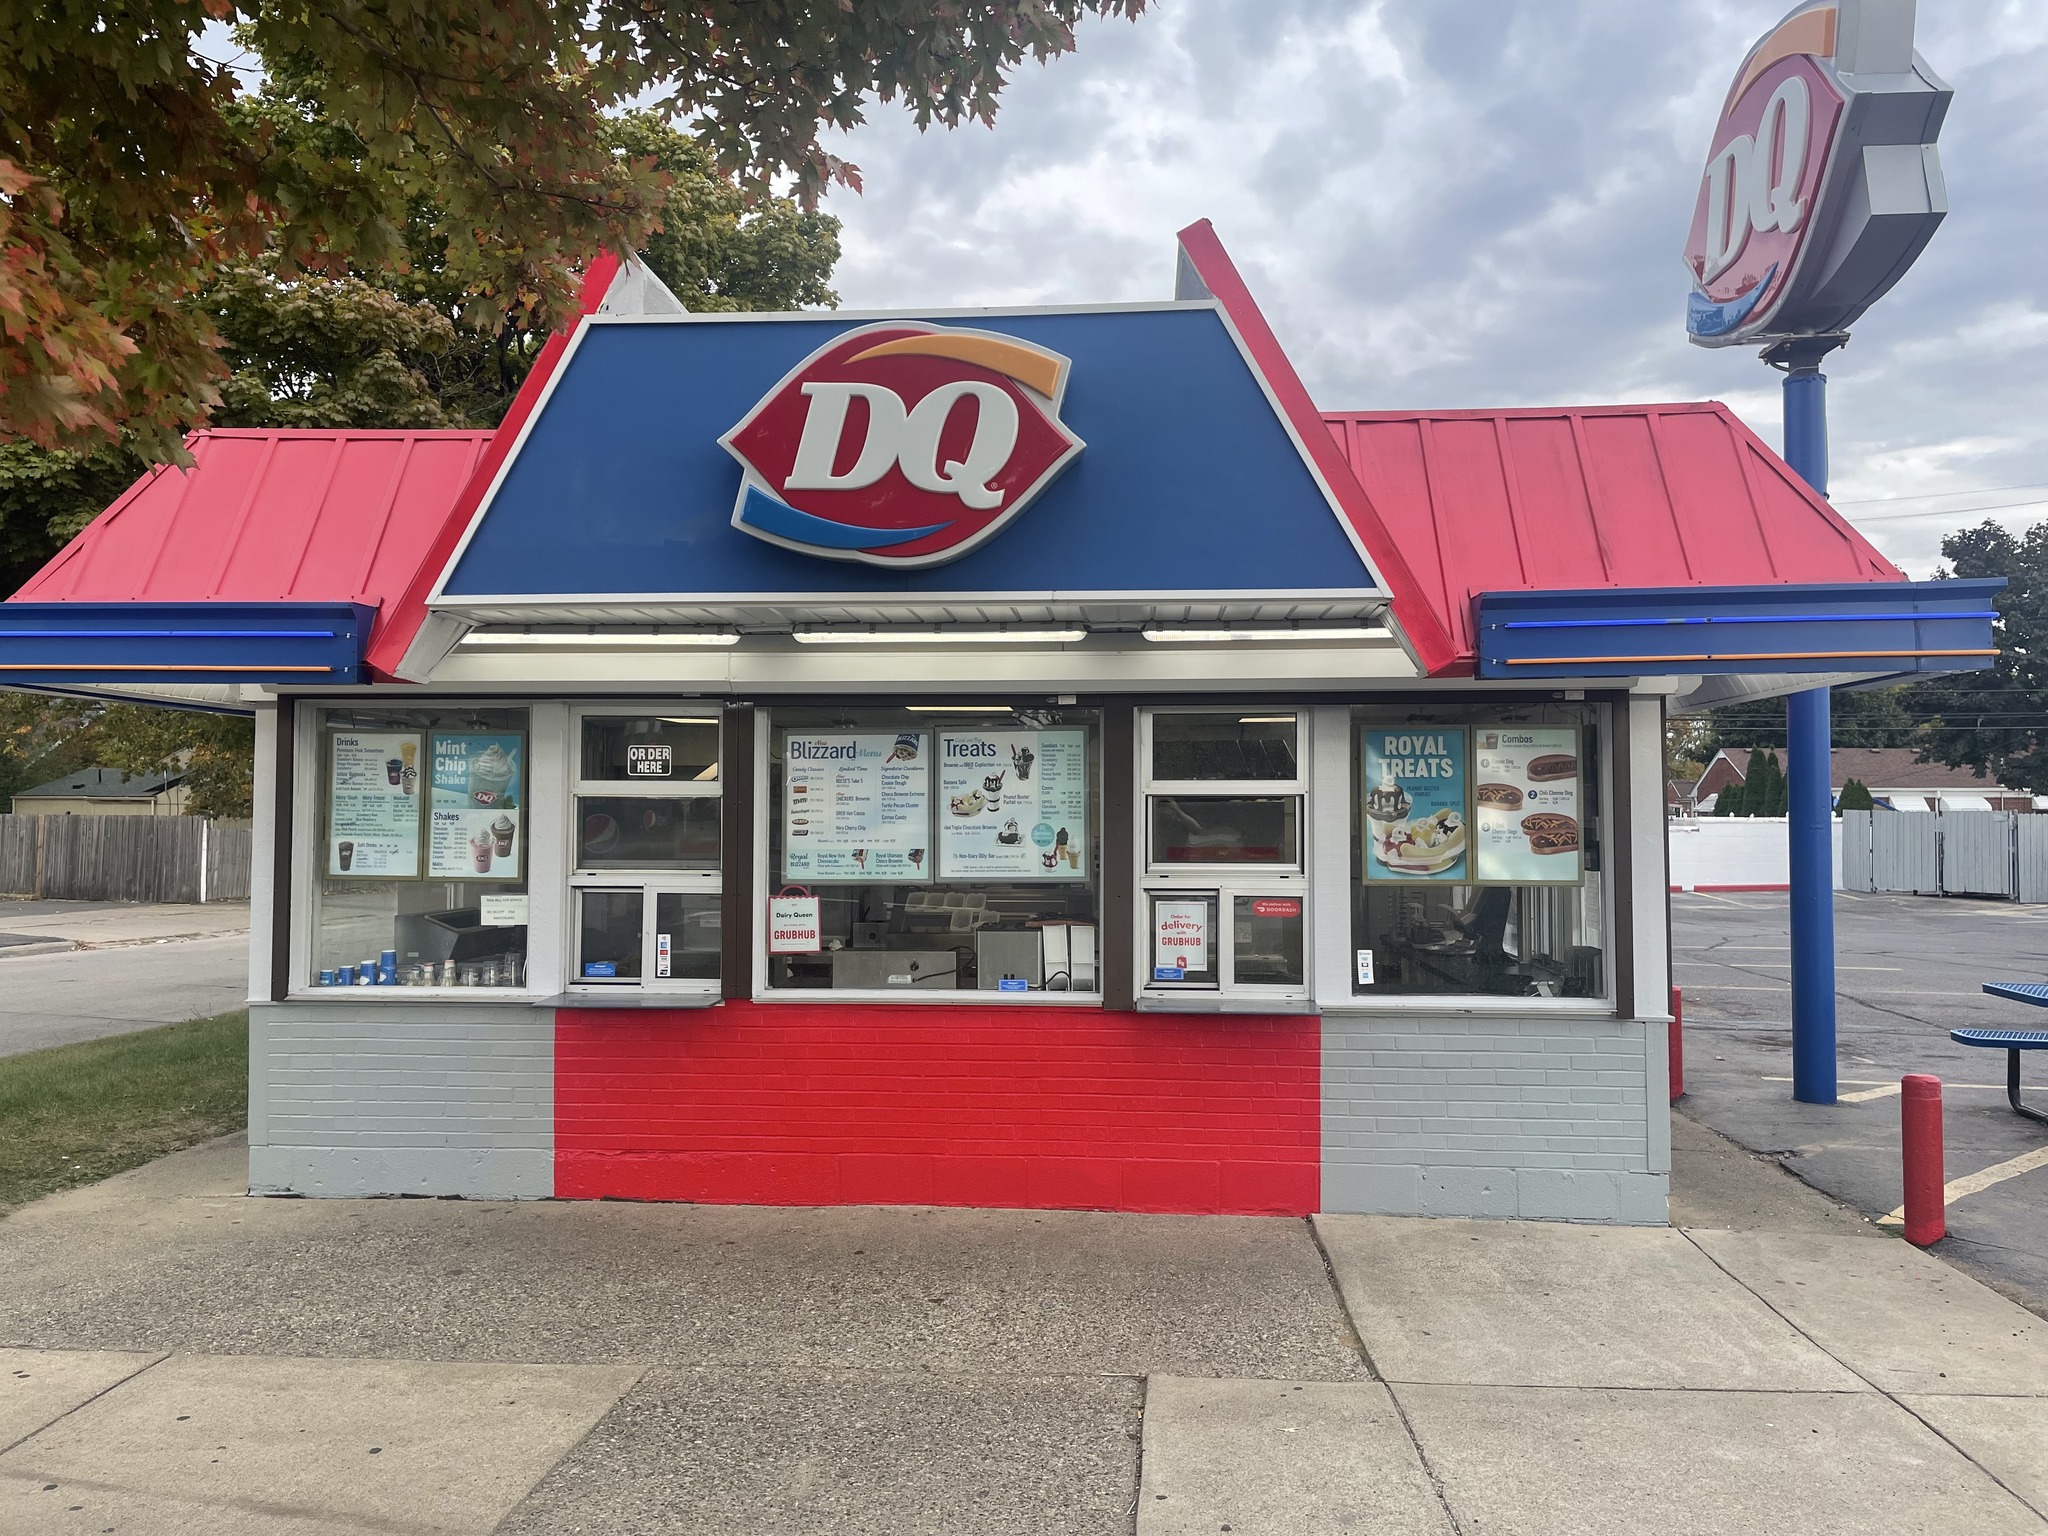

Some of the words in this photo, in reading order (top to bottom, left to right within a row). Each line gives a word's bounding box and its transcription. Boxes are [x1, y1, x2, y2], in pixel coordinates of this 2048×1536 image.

[1704, 76, 1809, 285] DQ
[783, 380, 1019, 510] DQ
[336, 737, 359, 746] Drinks
[1502, 734, 1533, 743] Combos
[435, 740, 467, 755] Mint
[791, 741, 857, 759] Blizzard
[857, 749, 882, 757] Menu
[943, 738, 997, 757] Treats
[1384, 736, 1448, 755] ROYAL
[435, 756, 467, 775] Chip
[637, 761, 663, 773] HERE
[1379, 758, 1454, 778] TREATS
[434, 773, 466, 785] Shake
[433, 812, 460, 821] Shakes
[789, 853, 808, 861] Royal
[1161, 921, 1203, 932] delivery
[774, 930, 816, 939] GRUBHUB
[1162, 936, 1201, 946] GRUBHUB
